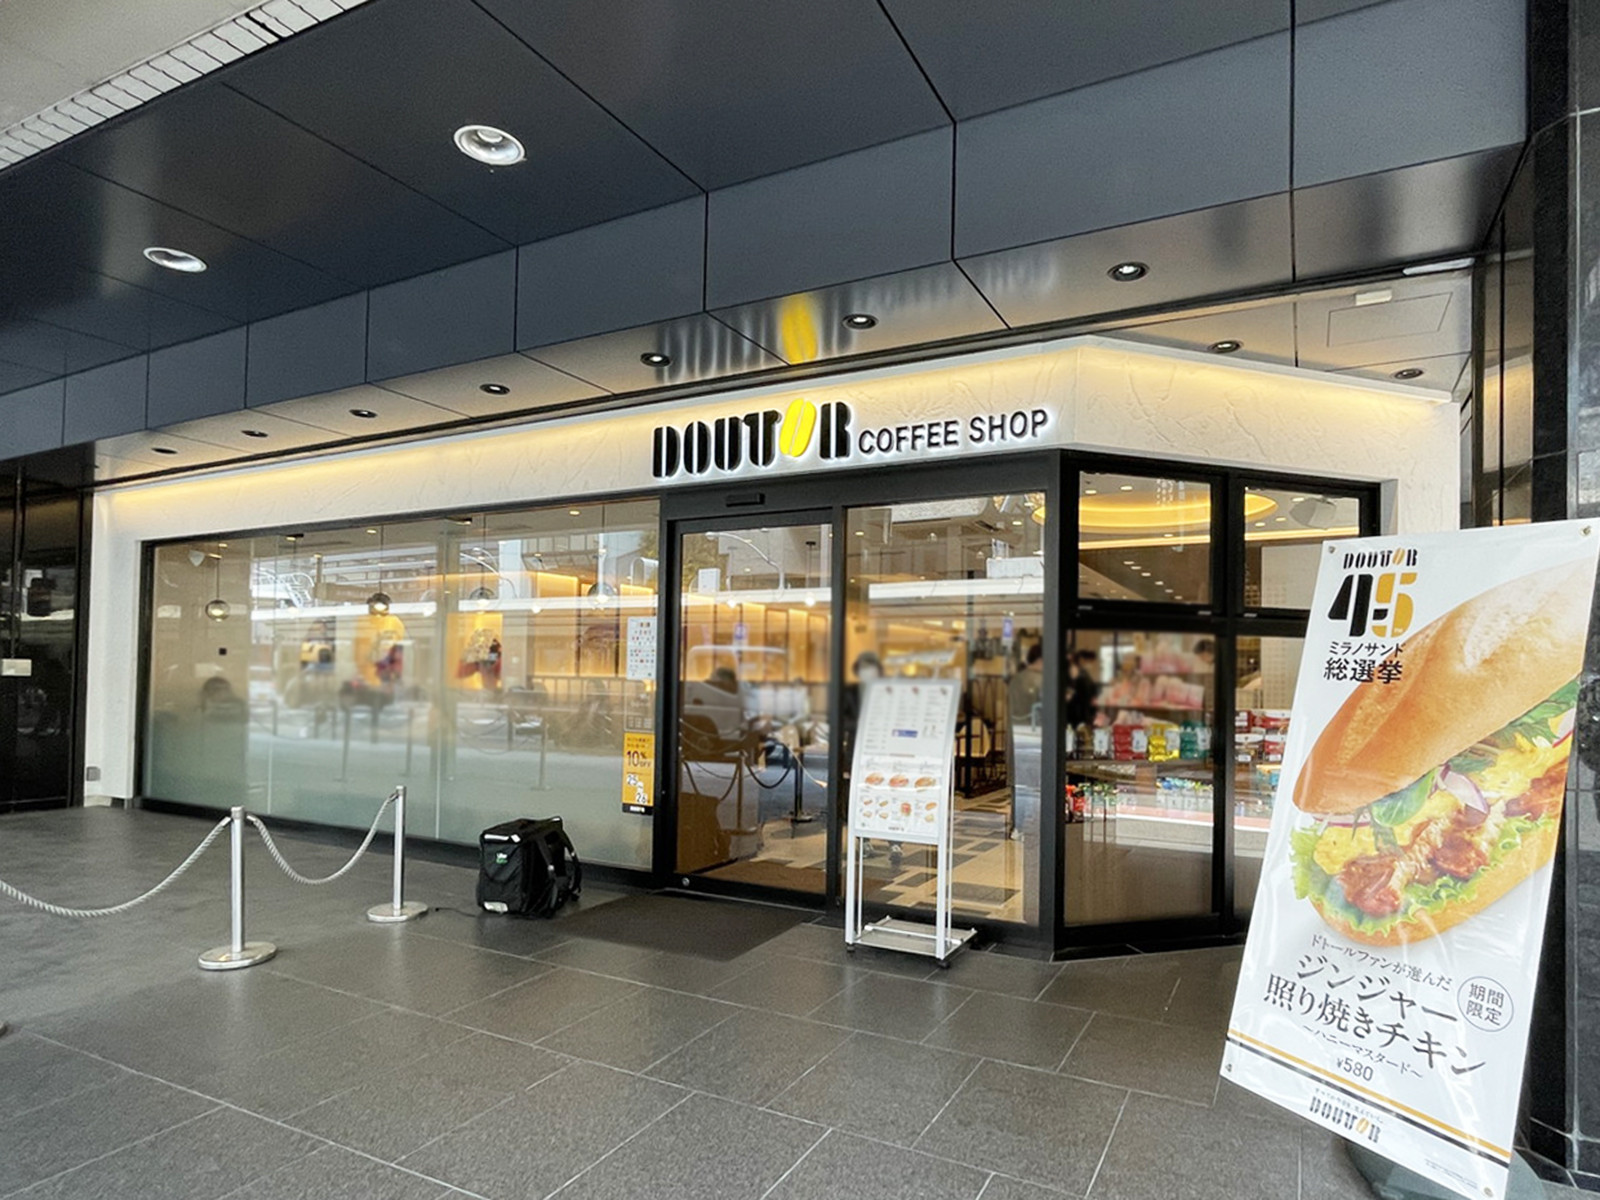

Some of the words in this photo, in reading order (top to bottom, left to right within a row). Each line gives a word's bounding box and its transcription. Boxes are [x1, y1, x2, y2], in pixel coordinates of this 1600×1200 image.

[653, 397, 851, 478] DOUTOR
[858, 419, 959, 455] COFFEE
[969, 408, 1048, 442] SHOP
[1343, 548, 1418, 570] DOUTOR
[1327, 572, 1418, 637] 45
[1323, 658, 1404, 684] 総選挙
[1329, 640, 1404, 657] ミラノサンド
[1312, 934, 1453, 992] ドトールファンが選んだ
[1297, 954, 1458, 1022] ジンジャー
[1468, 983, 1505, 1008] 期間
[1263, 973, 1486, 1075] 照り焼きチキン
[1466, 1000, 1502, 1026] 限定
[1309, 1095, 1381, 1143] DOUTOR
